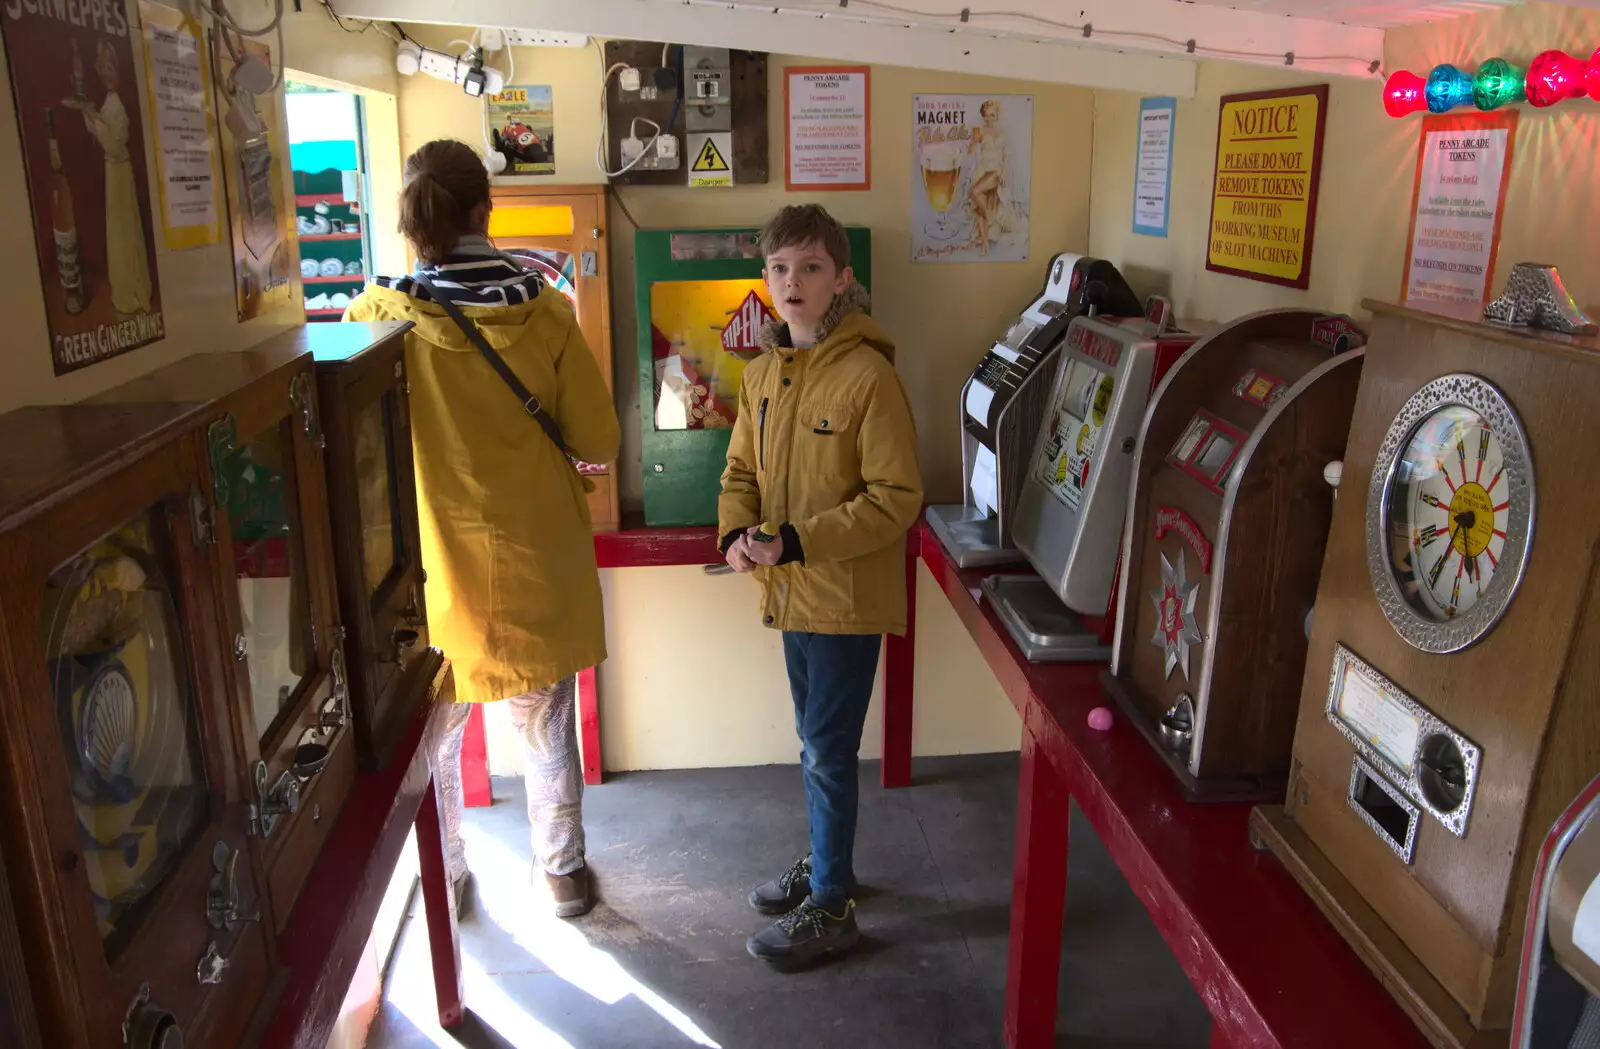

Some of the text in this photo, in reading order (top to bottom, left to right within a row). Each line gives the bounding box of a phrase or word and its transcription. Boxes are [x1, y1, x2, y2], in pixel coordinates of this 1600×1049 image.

[918, 111, 966, 124] MAGNET
[1232, 104, 1299, 135] NOTICE
[1439, 138, 1490, 149] PENNY ARCADE
[1225, 152, 1304, 169] PLEASE DO NOT
[1448, 151, 1476, 161] TOKENS
[1219, 177, 1304, 196] REMOVE TOKENS
[1232, 200, 1282, 218] FROM THIS
[1214, 219, 1300, 244] WORKING MUSEUM
[1212, 239, 1299, 266] OF SLOT MACHINES
[1414, 258, 1422, 267] NO
[1422, 259, 1448, 270] REFUNDS
[1457, 263, 1483, 274] TOKENS
[56, 313, 164, 364] GREEN GINGER WINE
